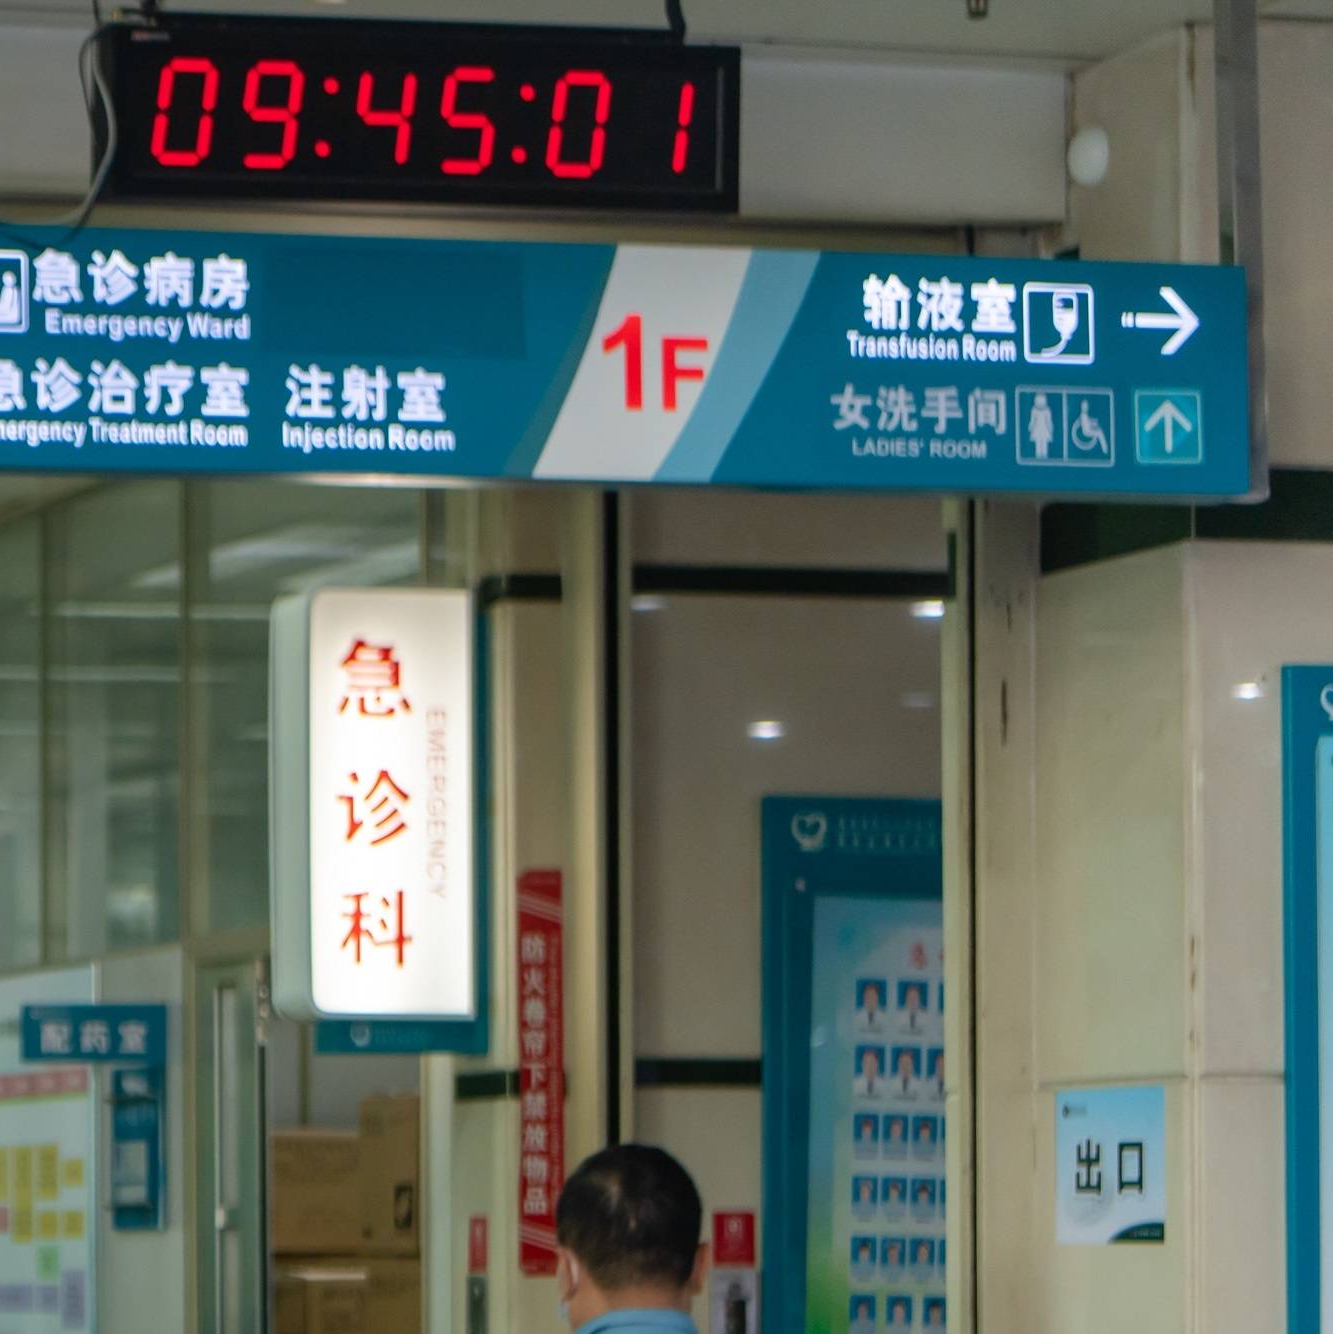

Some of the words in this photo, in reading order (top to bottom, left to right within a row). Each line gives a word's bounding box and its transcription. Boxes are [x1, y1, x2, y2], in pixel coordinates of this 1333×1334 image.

[150, 57, 694, 178] 09:45:01
[33, 248, 250, 310] 急诊病房
[863, 274, 1017, 331] 输液室
[45, 309, 183, 342] Emergency
[187, 313, 251, 340] Ward
[847, 330, 959, 362] Transfusion
[962, 333, 1017, 362] Room
[602, 314, 709, 412] 1F
[285, 364, 447, 423] 注射室
[831, 382, 1008, 436] 女洗手间
[90, 418, 188, 446] Treatment
[190, 419, 248, 448] Room
[282, 422, 384, 453] Injection
[388, 426, 456, 452] Room
[929, 438, 988, 459] ROOM
[337, 636, 412, 968] 急诊科
[1075, 1139, 1144, 1196] 出口
